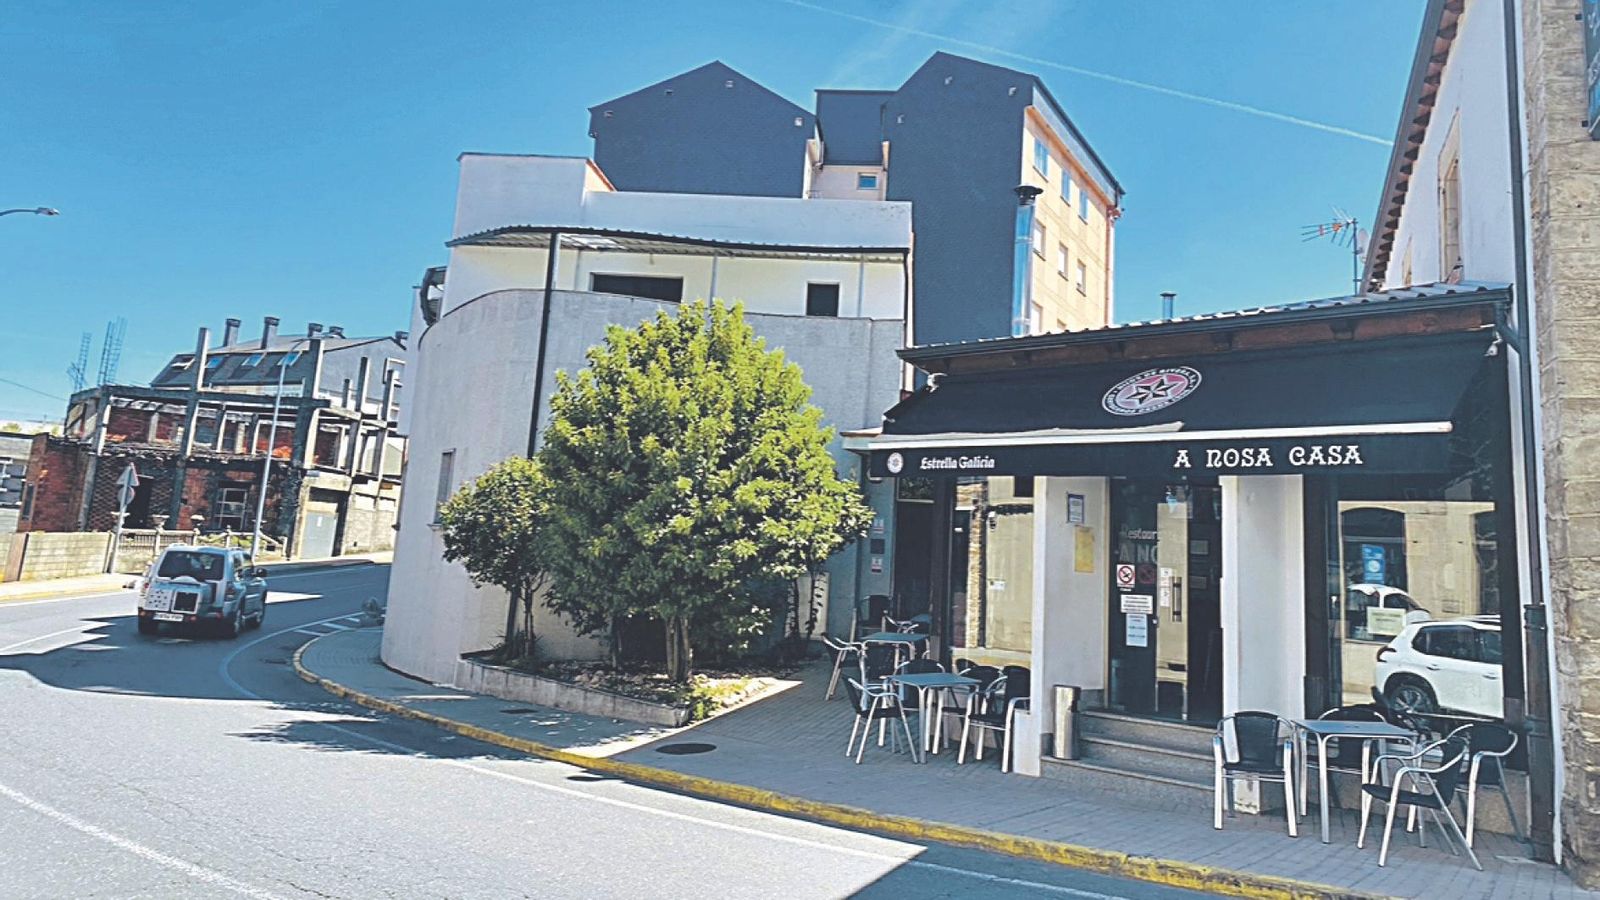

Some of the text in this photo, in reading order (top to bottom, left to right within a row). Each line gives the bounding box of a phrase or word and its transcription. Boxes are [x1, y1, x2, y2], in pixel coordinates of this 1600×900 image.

[919, 456, 957, 470] Estrella
[958, 455, 995, 469] Galicia
[1173, 445, 1363, 468] A NOSA CASA
